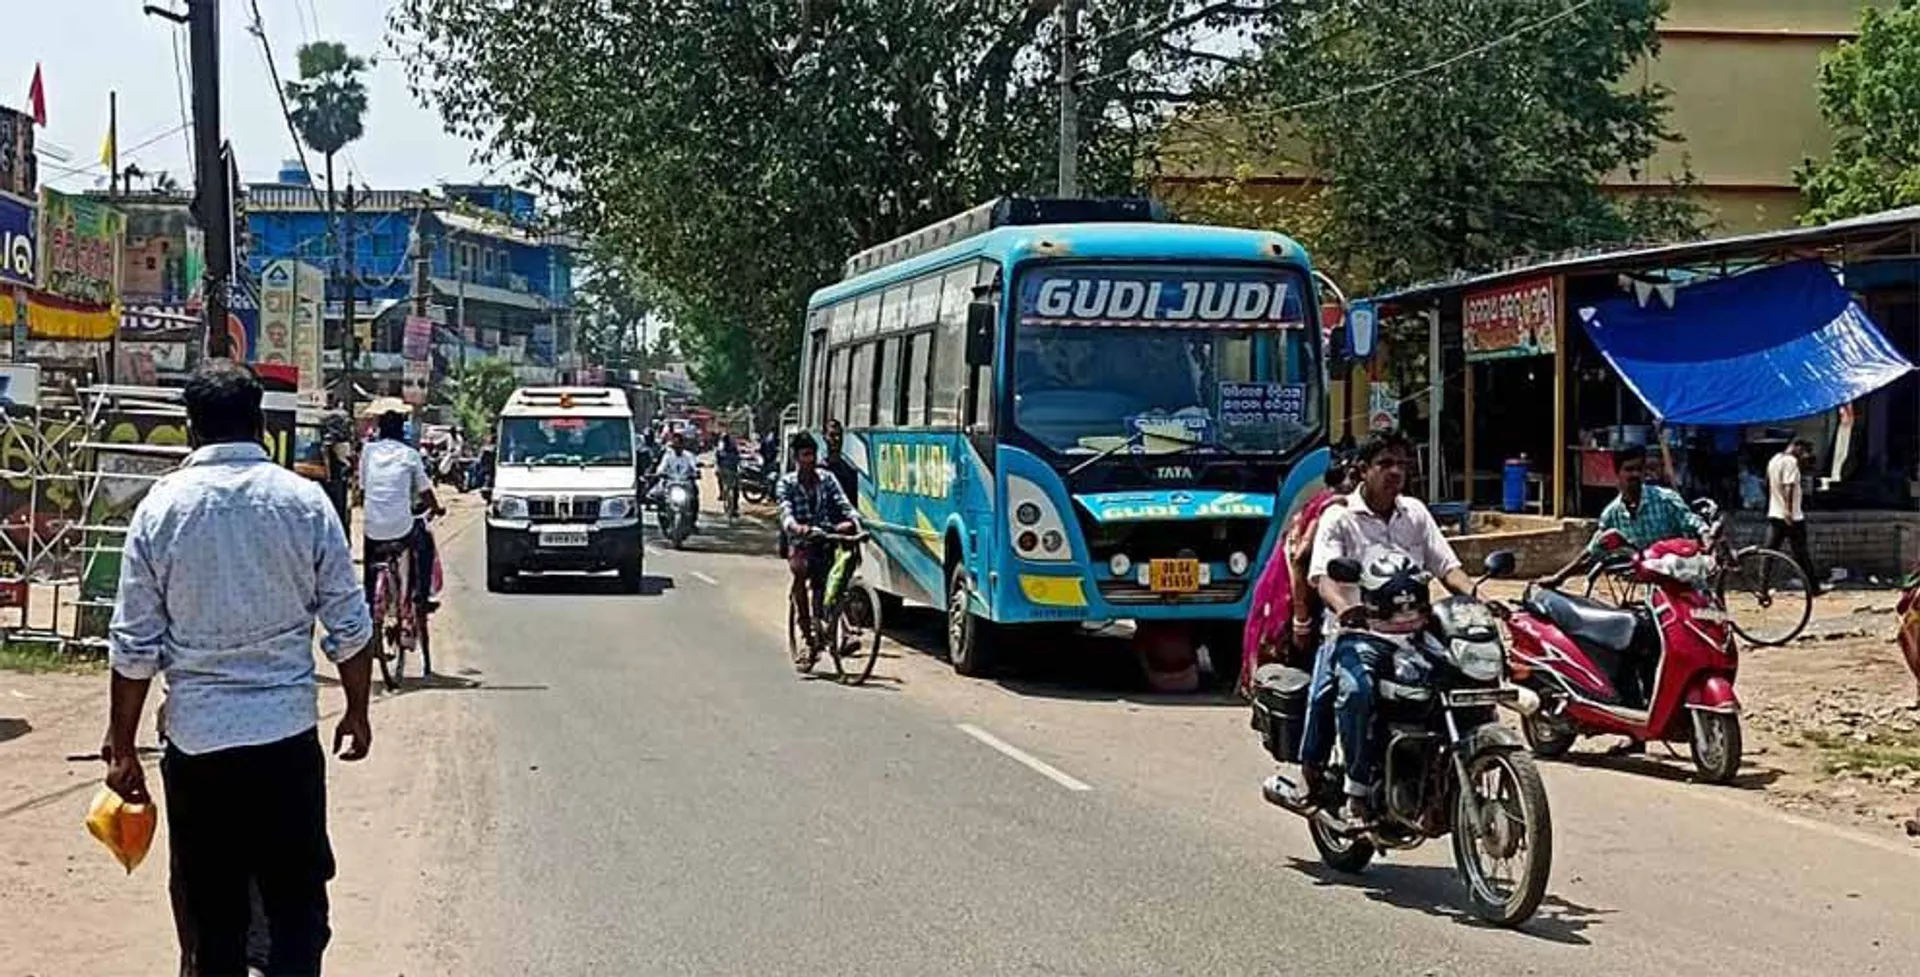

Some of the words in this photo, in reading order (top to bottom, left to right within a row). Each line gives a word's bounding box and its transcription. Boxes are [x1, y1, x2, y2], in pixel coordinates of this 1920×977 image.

[1037, 279, 1162, 319] GUDI
[1166, 281, 1289, 320] JUDI
[1156, 466, 1193, 479] TATA
[1103, 504, 1179, 519] GUDI
[1195, 502, 1265, 516] JUDI
